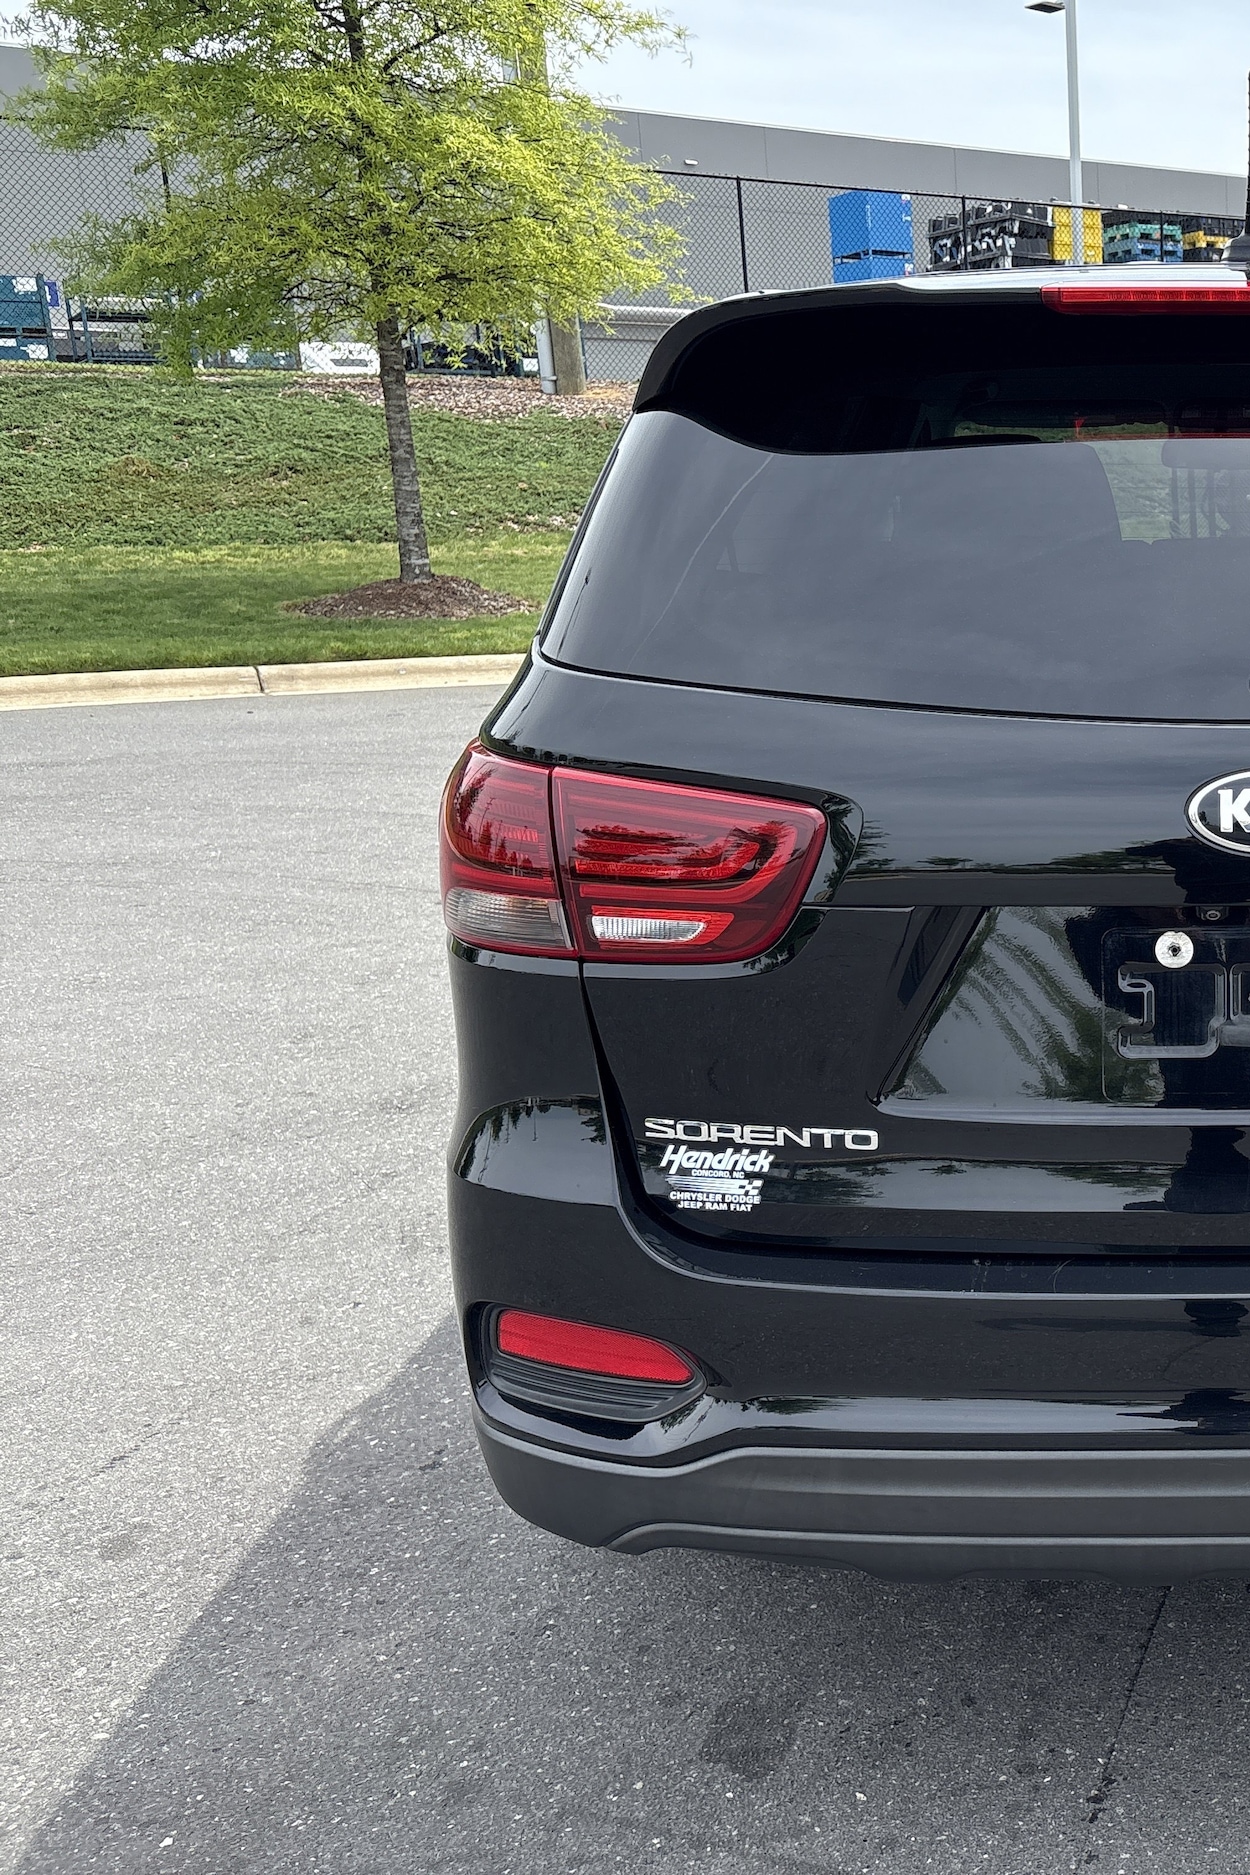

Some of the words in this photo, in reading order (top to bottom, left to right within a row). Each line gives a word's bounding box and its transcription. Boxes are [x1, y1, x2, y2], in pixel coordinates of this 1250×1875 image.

[644, 1117, 879, 1150] SORENTO
[659, 1144, 775, 1174] Hendrick
[691, 1169, 731, 1178] CONCORD,
[669, 1191, 722, 1202] CHRYSLER
[724, 1194, 761, 1204] DODGE
[677, 1201, 703, 1209] JEEP
[705, 1202, 728, 1211] RAM
[730, 1204, 753, 1212] FIAT
